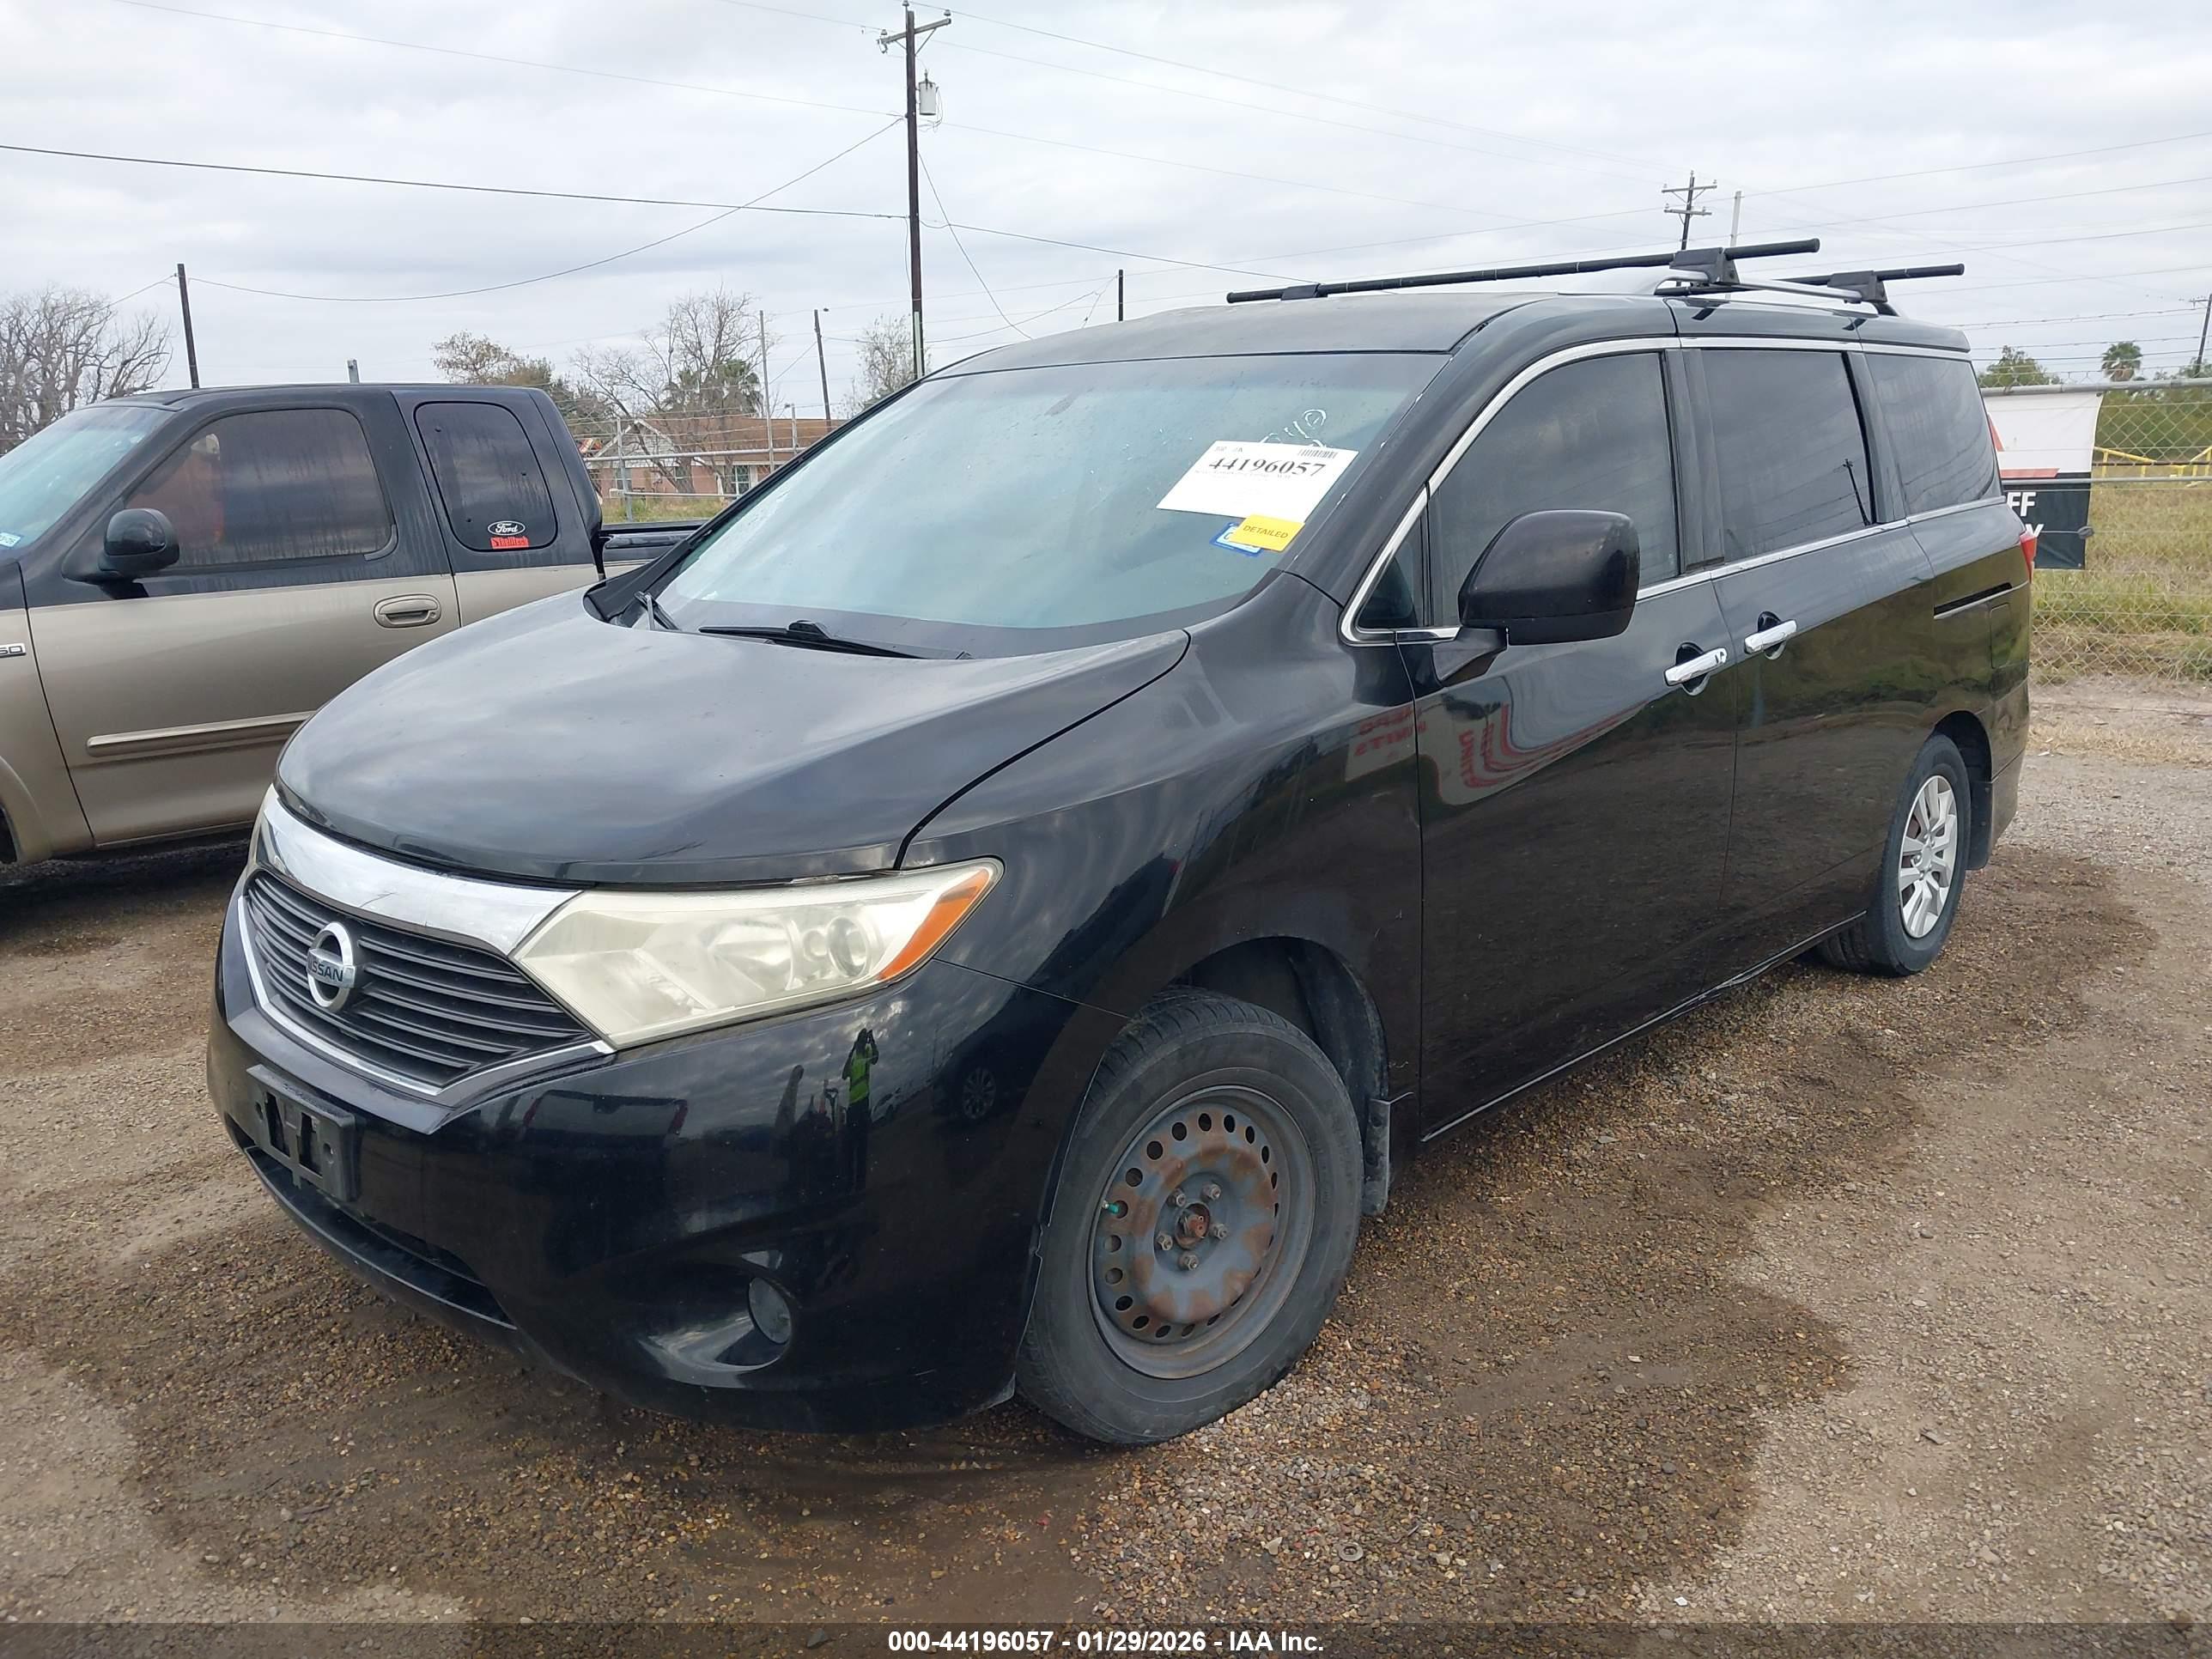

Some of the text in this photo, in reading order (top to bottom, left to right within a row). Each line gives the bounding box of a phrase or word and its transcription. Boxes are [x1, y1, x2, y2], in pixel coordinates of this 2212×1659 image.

[1209, 457, 1326, 476] 44196057
[495, 523, 518, 532] Ford
[1243, 525, 1288, 538] DETAILED
